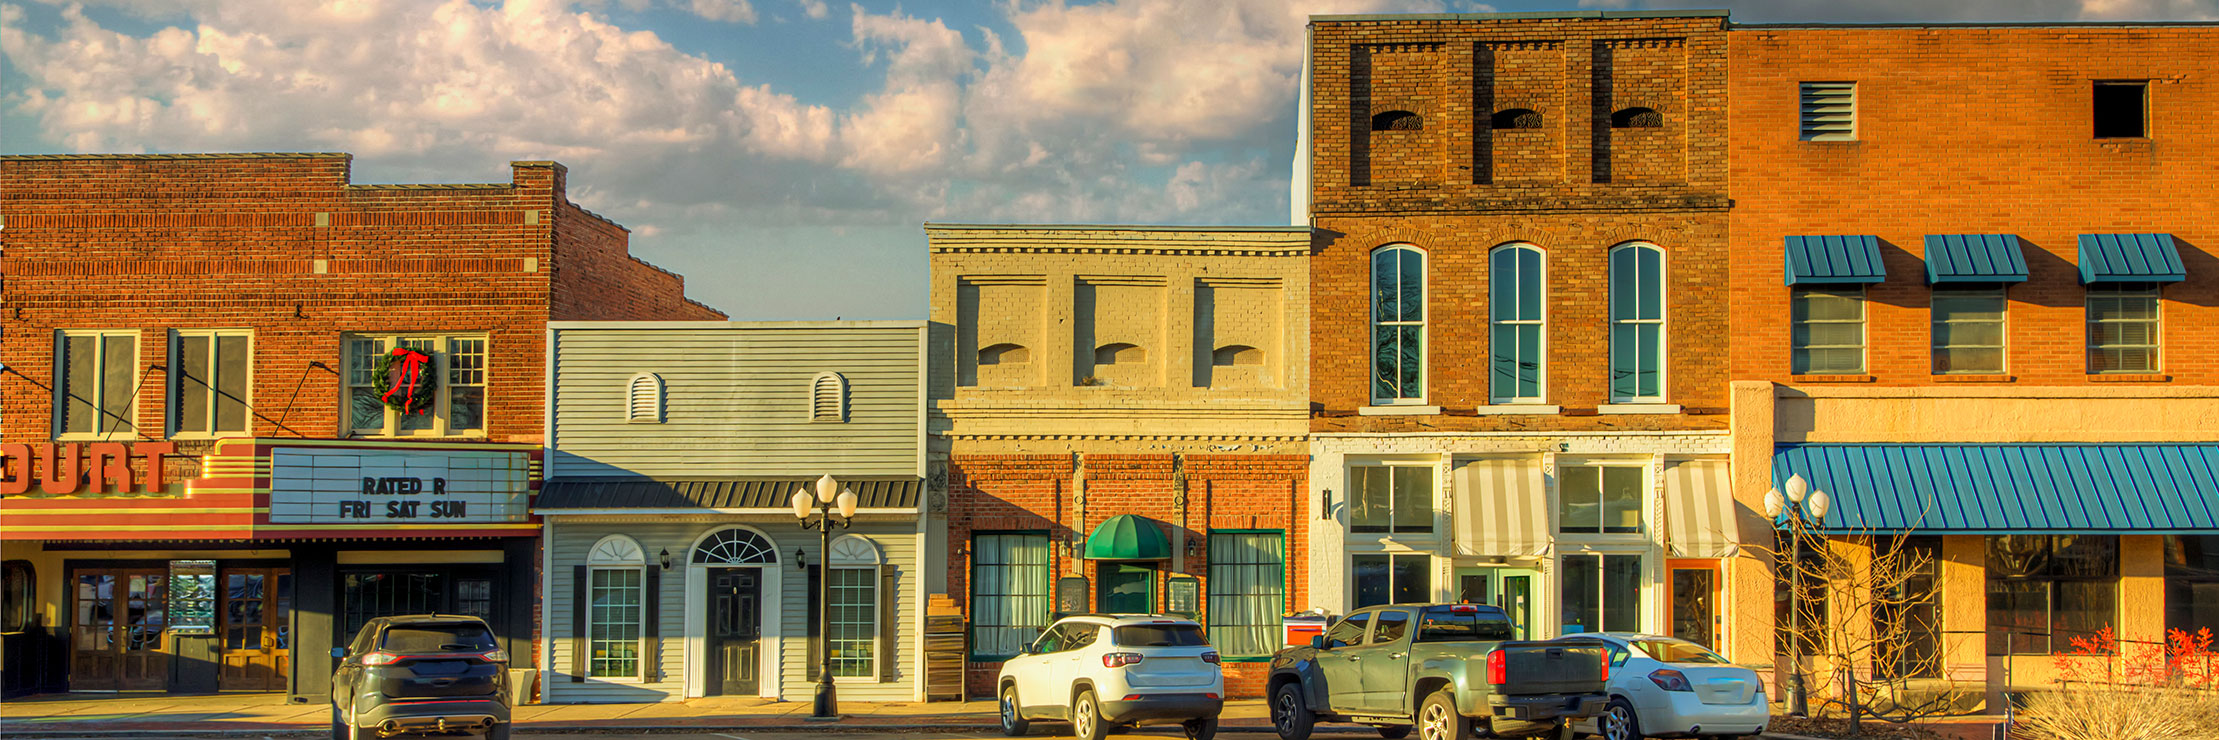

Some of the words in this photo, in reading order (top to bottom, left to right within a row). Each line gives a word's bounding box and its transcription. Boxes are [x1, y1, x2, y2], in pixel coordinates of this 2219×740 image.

[363, 477, 422, 495] RATED
[433, 477, 446, 495] R
[340, 501, 371, 518] FRI
[386, 501, 421, 518] SAT
[430, 501, 466, 518] SUN
